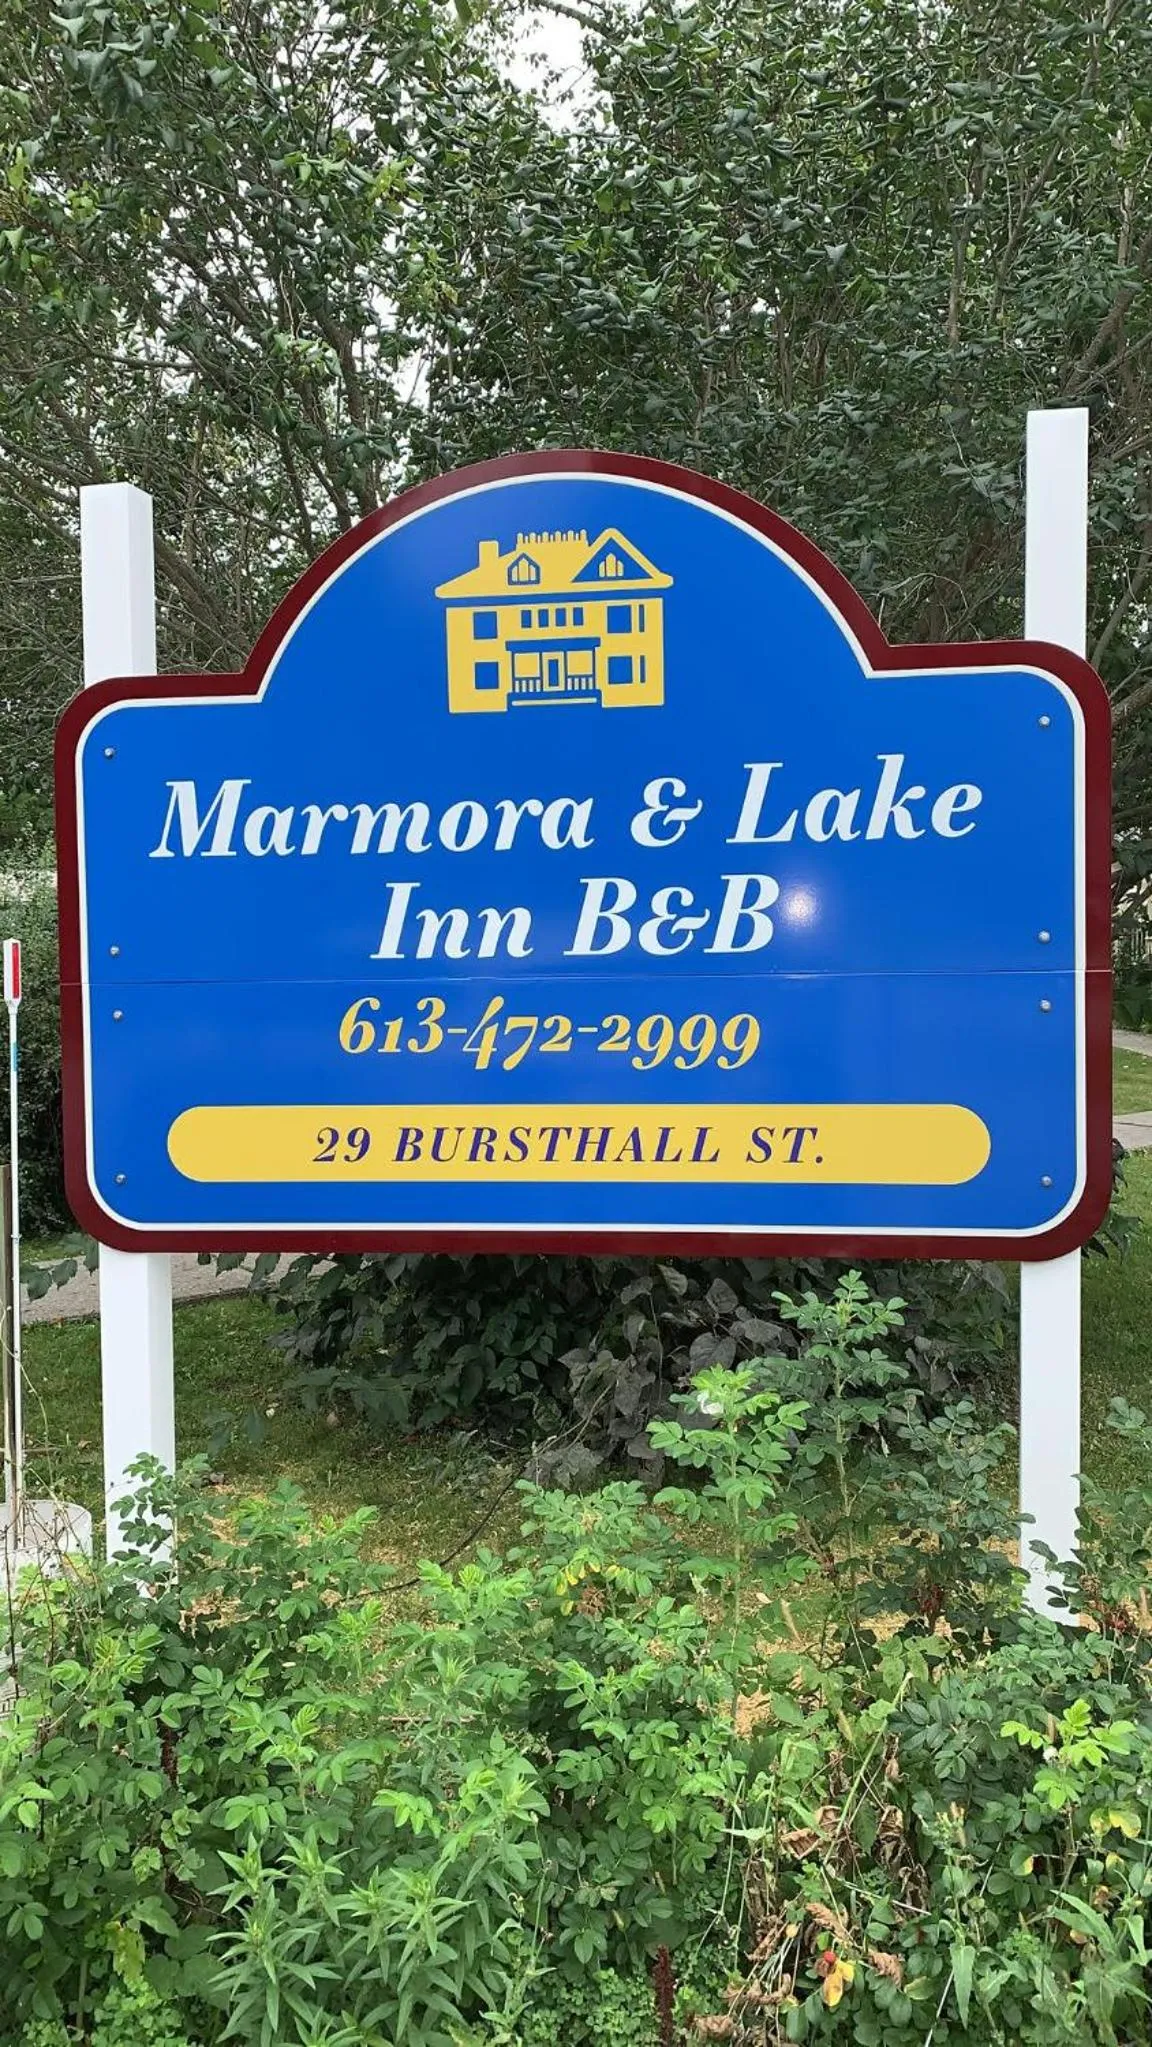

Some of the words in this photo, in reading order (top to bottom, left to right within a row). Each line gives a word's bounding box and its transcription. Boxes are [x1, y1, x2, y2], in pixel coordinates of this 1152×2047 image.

[149, 779, 594, 859] Marmora
[630, 777, 703, 848] &
[726, 753, 983, 845] Lake
[370, 882, 534, 960] Inn
[563, 874, 780, 957] B&B
[339, 996, 761, 1071] 613-472-2999
[312, 1126, 371, 1164] 29
[393, 1126, 720, 1164] BURSTHALL
[746, 1126, 823, 1165] ST.
